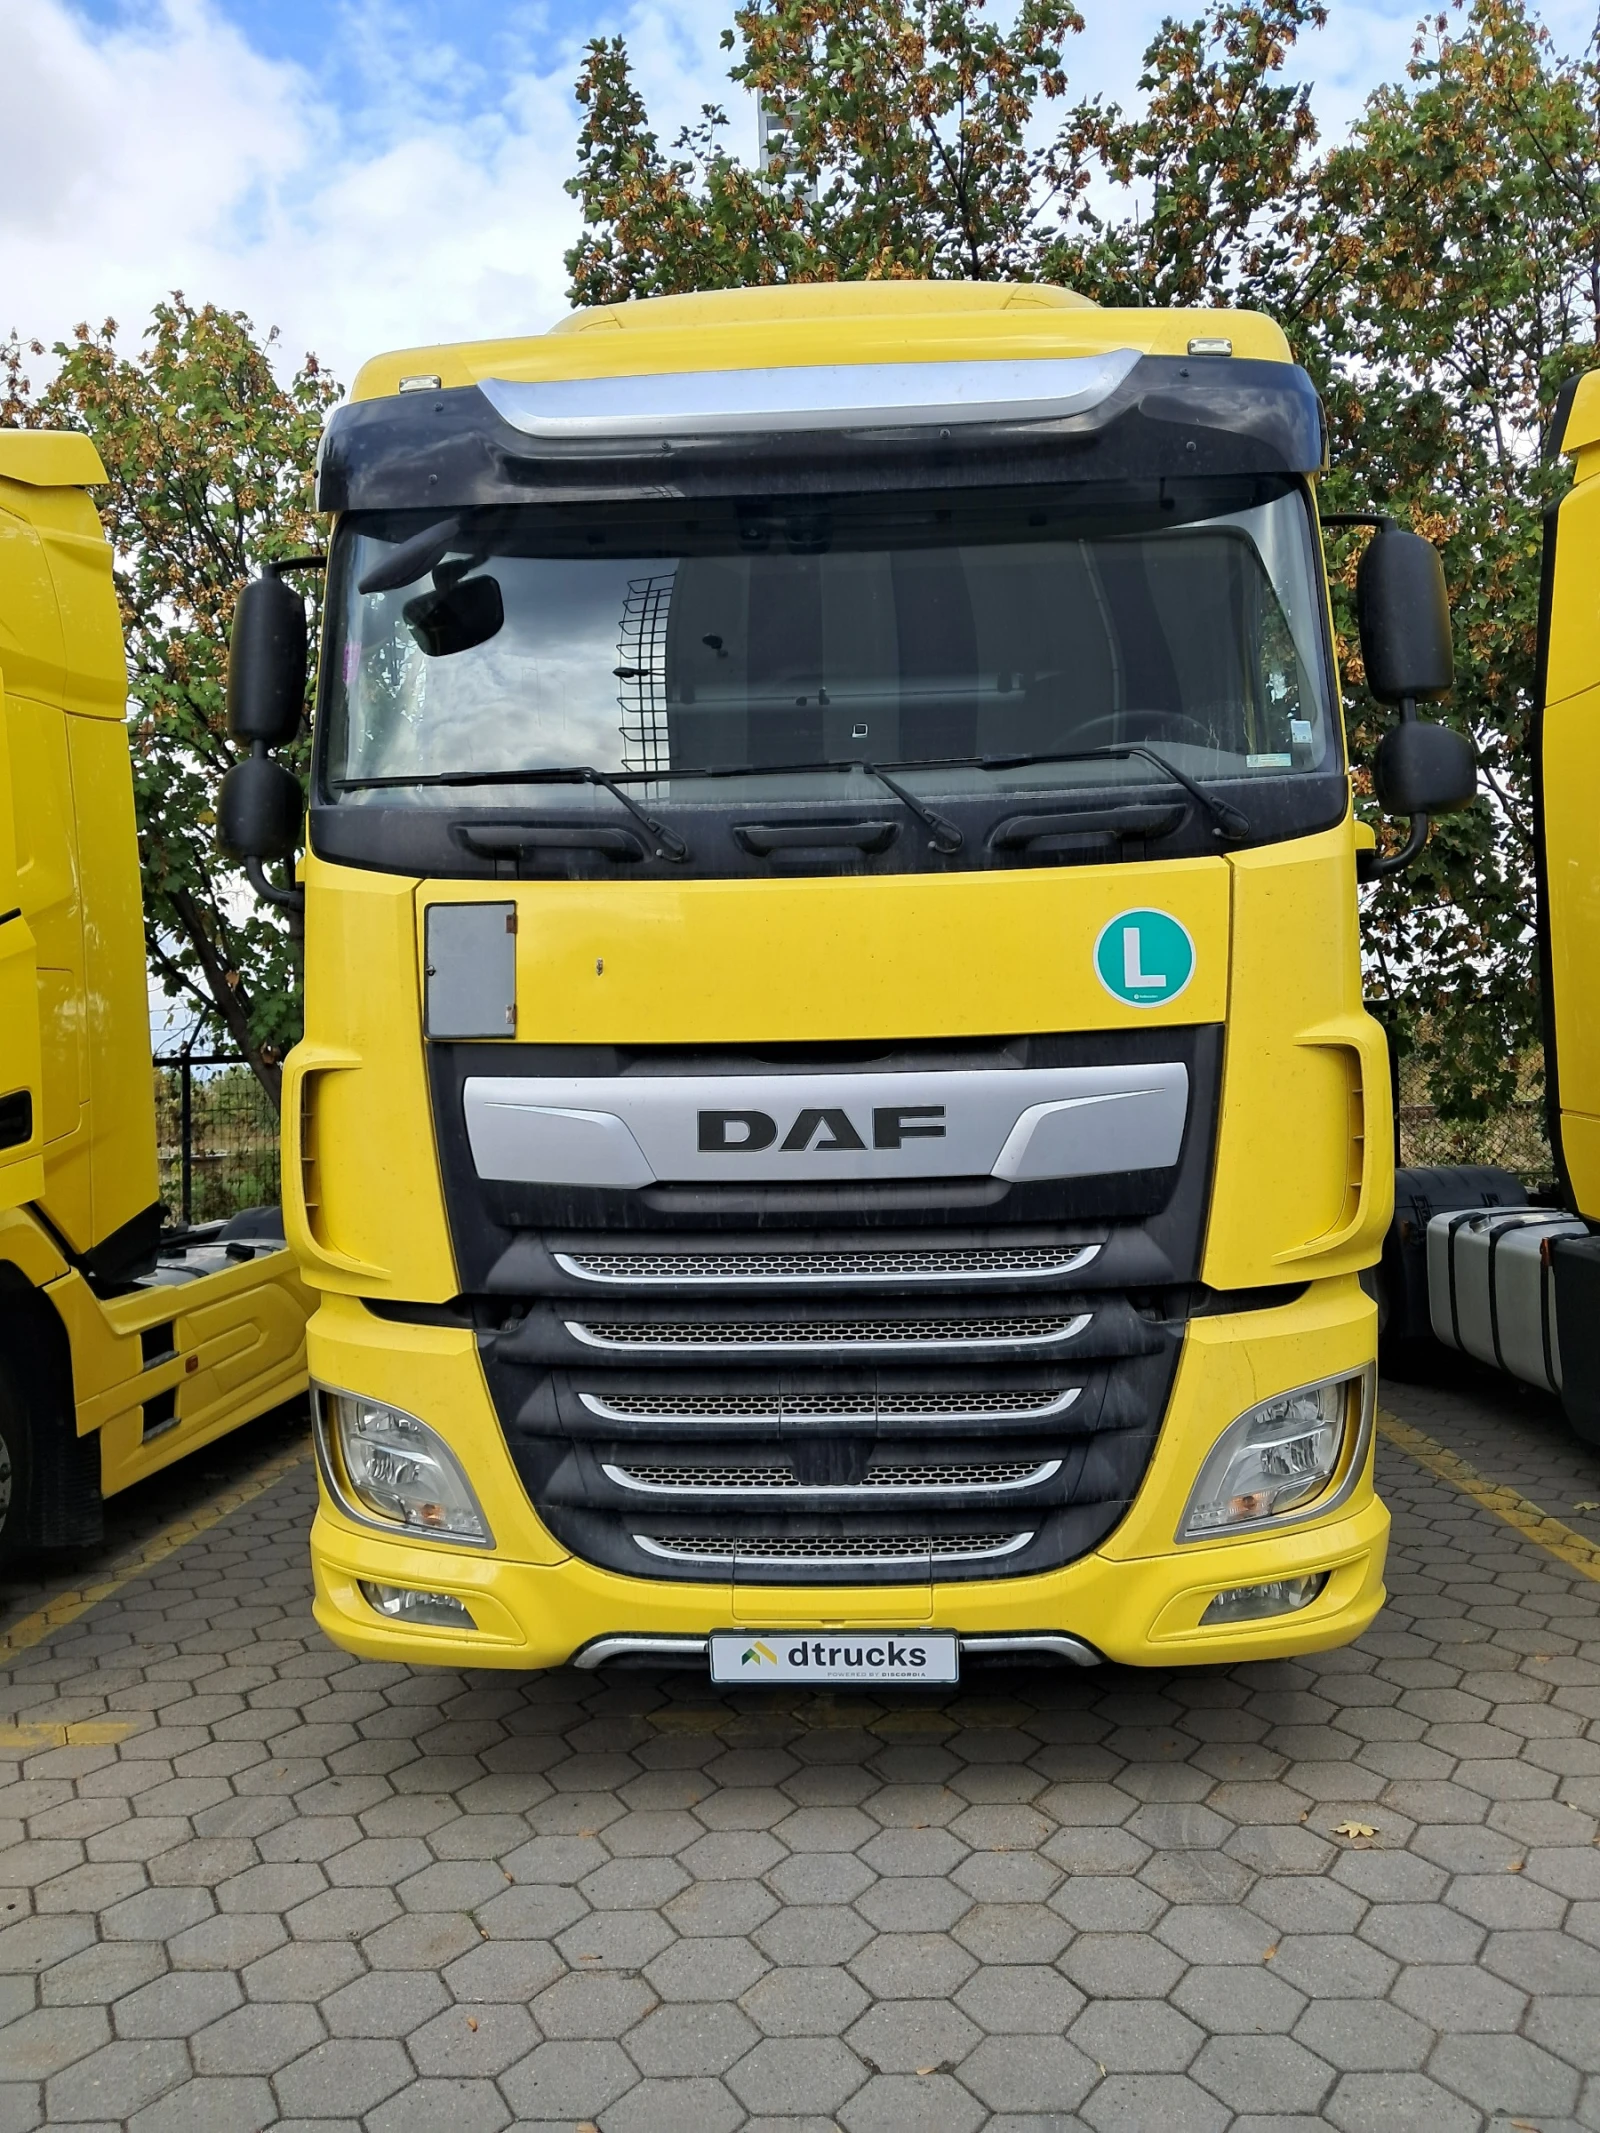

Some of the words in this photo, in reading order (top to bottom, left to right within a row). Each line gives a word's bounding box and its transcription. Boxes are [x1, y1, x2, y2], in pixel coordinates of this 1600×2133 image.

[1123, 927, 1167, 988] L
[697, 1104, 946, 1152] DAF
[788, 1641, 927, 1667] dtrucks
